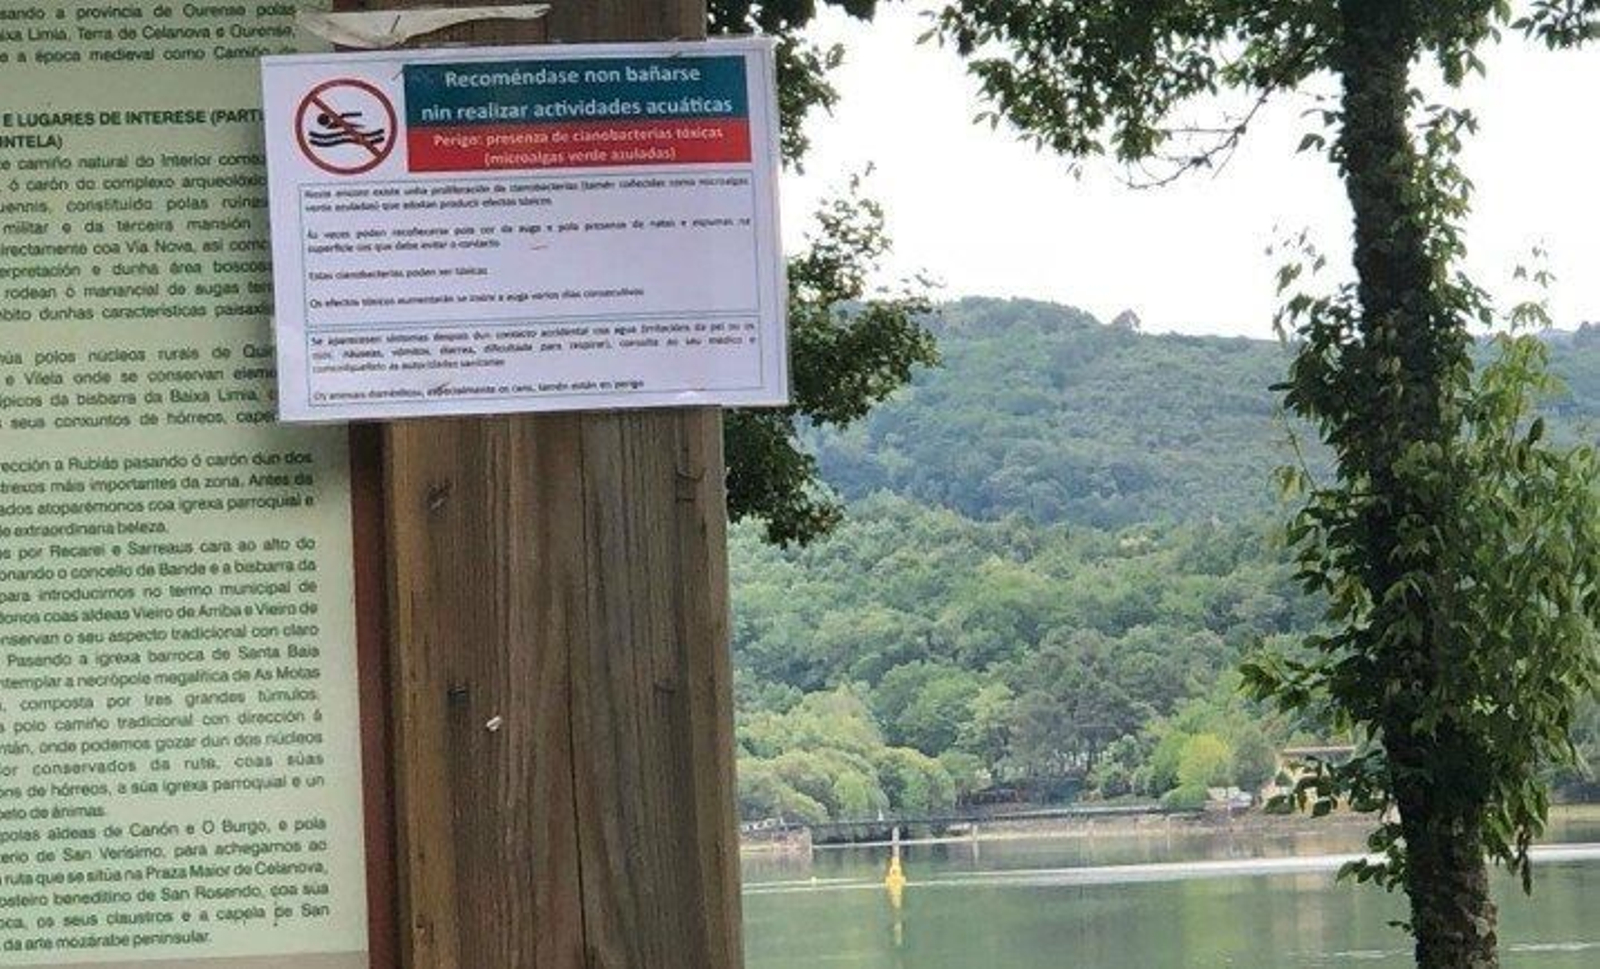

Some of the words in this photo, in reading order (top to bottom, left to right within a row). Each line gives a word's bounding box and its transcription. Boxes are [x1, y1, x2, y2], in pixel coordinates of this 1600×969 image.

[152, 4, 172, 18] de
[182, 3, 246, 18] Ourense
[77, 26, 113, 40] Terra
[141, 24, 210, 40] Celanova
[229, 23, 295, 38] Ourense,
[89, 47, 155, 62] medieval
[163, 48, 206, 60] como
[444, 68, 579, 87] Recoméndase
[584, 69, 620, 82] non
[625, 65, 700, 81] bañarse
[421, 104, 451, 120] nin
[457, 102, 528, 120] realizar
[533, 97, 641, 117] actividades
[646, 97, 732, 114] acuáticas
[3, 112, 13, 127] E
[17, 111, 95, 127] LUGARES
[99, 111, 121, 125] DE
[125, 109, 206, 125] INTERESE
[433, 133, 481, 148] Perigo:
[486, 133, 548, 146] presenza
[551, 130, 568, 143] de
[572, 129, 672, 141] cianobacterias
[676, 126, 723, 138] tóxicas
[17, 155, 72, 170] camiño
[77, 155, 128, 169] natural
[160, 152, 212, 167] Interior
[484, 150, 564, 167] (microalgas
[567, 148, 607, 162] verde
[610, 146, 676, 160] azuladas)
[25, 176, 69, 192] carón
[102, 176, 175, 191] complexo
[2, 220, 49, 235] militar
[116, 219, 174, 233] terceira
[186, 216, 251, 231] mansión
[111, 261, 159, 276] dunha
[4, 286, 57, 300] rodean
[83, 283, 159, 298] manancial
[194, 282, 239, 297] augas
[38, 306, 94, 321] dunhas
[34, 349, 76, 367] polos
[157, 346, 199, 361] rurais
[72, 370, 111, 385] onde
[146, 369, 223, 383] conservan
[76, 392, 136, 406] bisbarra
[169, 388, 210, 403] Baixa
[10, 417, 45, 430] seus
[53, 414, 131, 428] conxuntos
[123, 454, 188, 471] pasando
[205, 453, 248, 467] carón
[50, 479, 85, 492] máis
[89, 477, 177, 493] importantes
[248, 473, 289, 486] Antes
[37, 501, 144, 515] atoparémonos
[179, 498, 223, 513] igrexa
[226, 495, 301, 511] parroquial
[198, 540, 232, 553] cara
[70, 564, 133, 579] concello
[158, 561, 206, 577] Bande
[233, 560, 295, 573] bisbarra
[168, 584, 212, 597] termo
[219, 580, 291, 596] municipal
[43, 610, 79, 623] coas
[81, 608, 130, 622] aldeas
[132, 606, 174, 620] Vieiro
[108, 628, 167, 644] aspecto
[171, 624, 246, 640] tradicional
[282, 623, 319, 637] claro
[6, 652, 72, 667] Pasando
[95, 651, 141, 667] igrexa
[147, 649, 205, 663] barroca
[238, 645, 280, 660] Santa
[276, 665, 320, 679] Motas
[18, 696, 94, 711] composta
[143, 693, 173, 706] tres
[184, 691, 246, 708] grandes
[54, 716, 109, 732] camiño
[116, 712, 193, 729] tradicional
[236, 710, 305, 725] dirección
[39, 740, 77, 754] onde
[80, 738, 151, 754] podemos
[155, 736, 197, 753] gozar
[32, 759, 136, 776] conservados
[286, 753, 324, 766] súas
[162, 779, 208, 796] igrexa
[212, 776, 287, 793] parroquial
[46, 826, 96, 841] aldeas
[128, 821, 179, 837] Canón
[294, 816, 326, 833] pola
[4, 872, 33, 885] ruta
[145, 865, 187, 879] Praza
[189, 864, 230, 878] Maior
[254, 861, 329, 876] Celanova,
[53, 890, 132, 906] beneditino
[160, 886, 190, 901] San
[63, 913, 98, 927] seus
[106, 910, 174, 925] claustros
[215, 905, 266, 924] capela
[300, 902, 330, 918] San
[25, 937, 52, 950] arte
